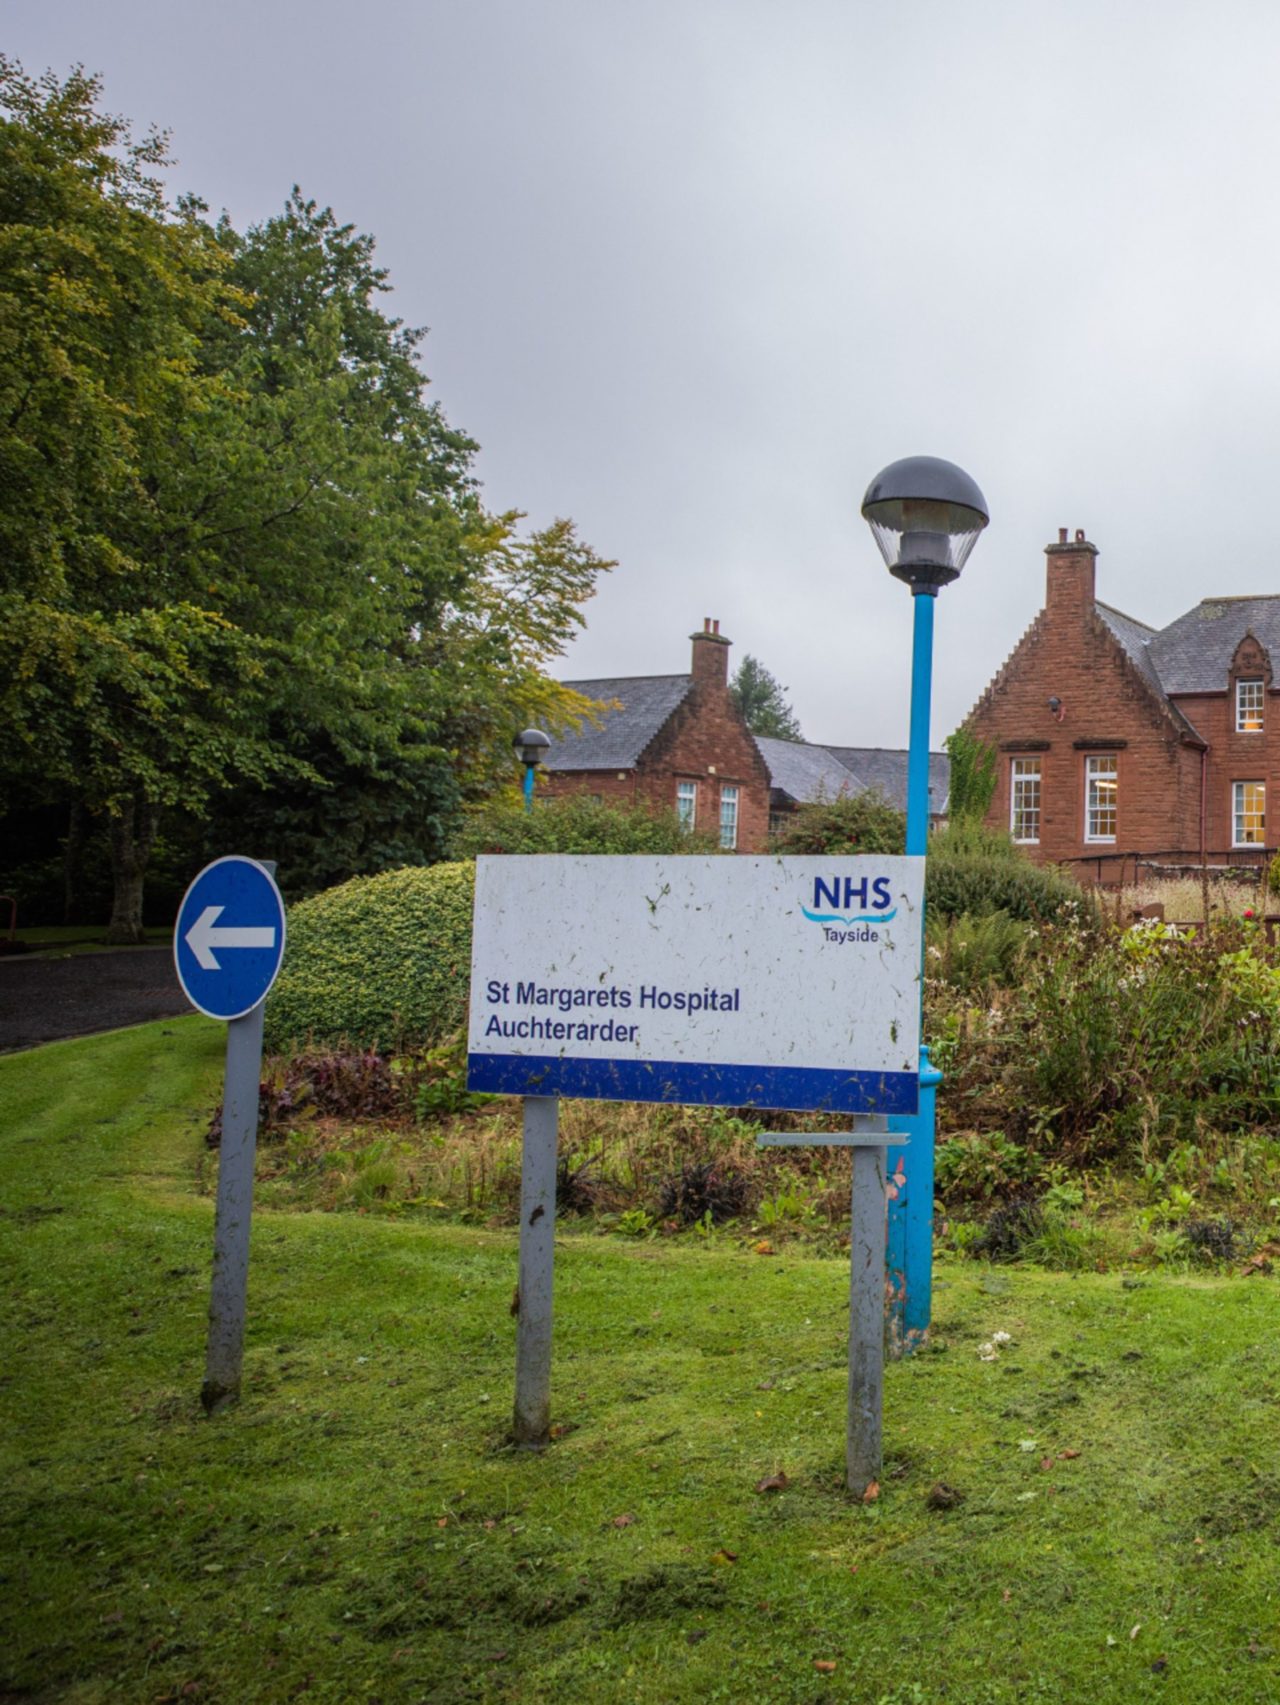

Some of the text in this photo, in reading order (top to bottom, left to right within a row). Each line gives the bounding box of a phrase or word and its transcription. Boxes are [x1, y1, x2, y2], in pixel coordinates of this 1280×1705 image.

[814, 876, 892, 910] NHS
[823, 926, 879, 943] Tayside
[485, 981, 740, 1016] St Margarets Hospital
[485, 1014, 639, 1042] Auchterarder
